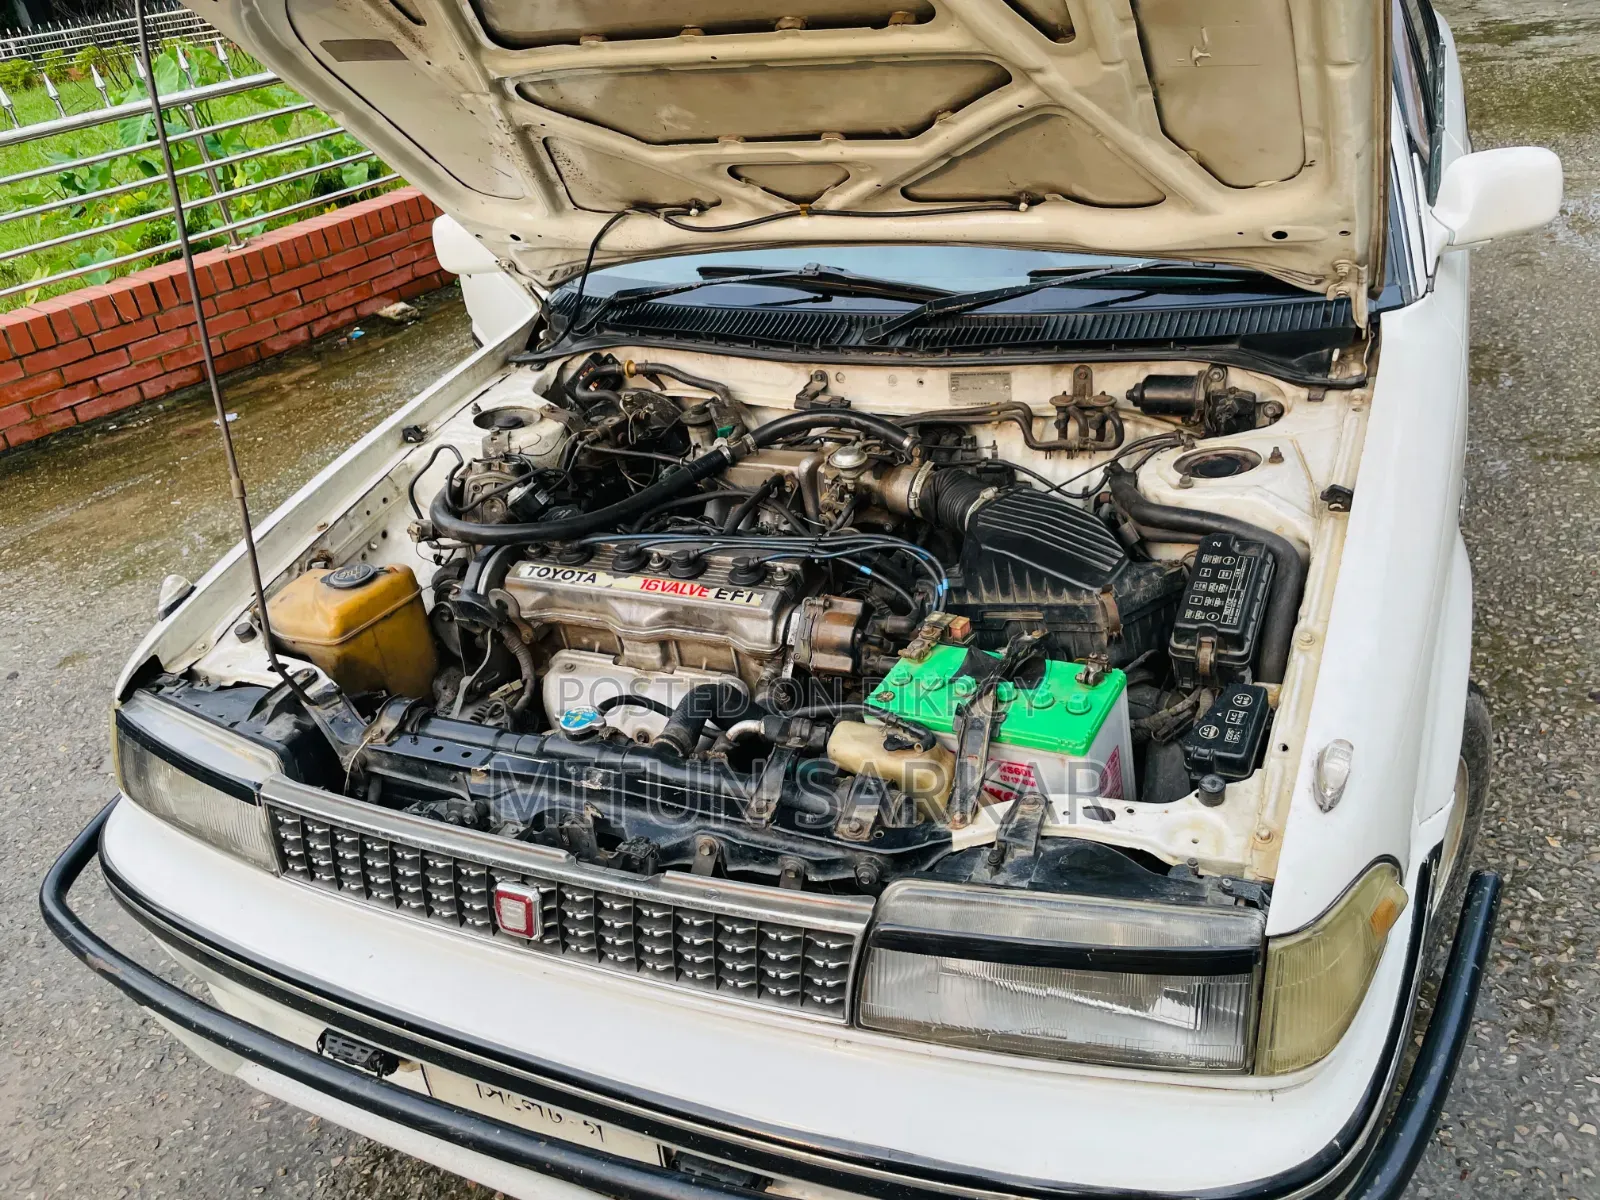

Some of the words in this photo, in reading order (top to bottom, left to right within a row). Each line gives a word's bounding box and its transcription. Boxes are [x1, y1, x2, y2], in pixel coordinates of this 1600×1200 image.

[528, 565, 597, 584] TOYOTA
[639, 578, 710, 598] 16VALVE
[714, 587, 754, 604] EFI
